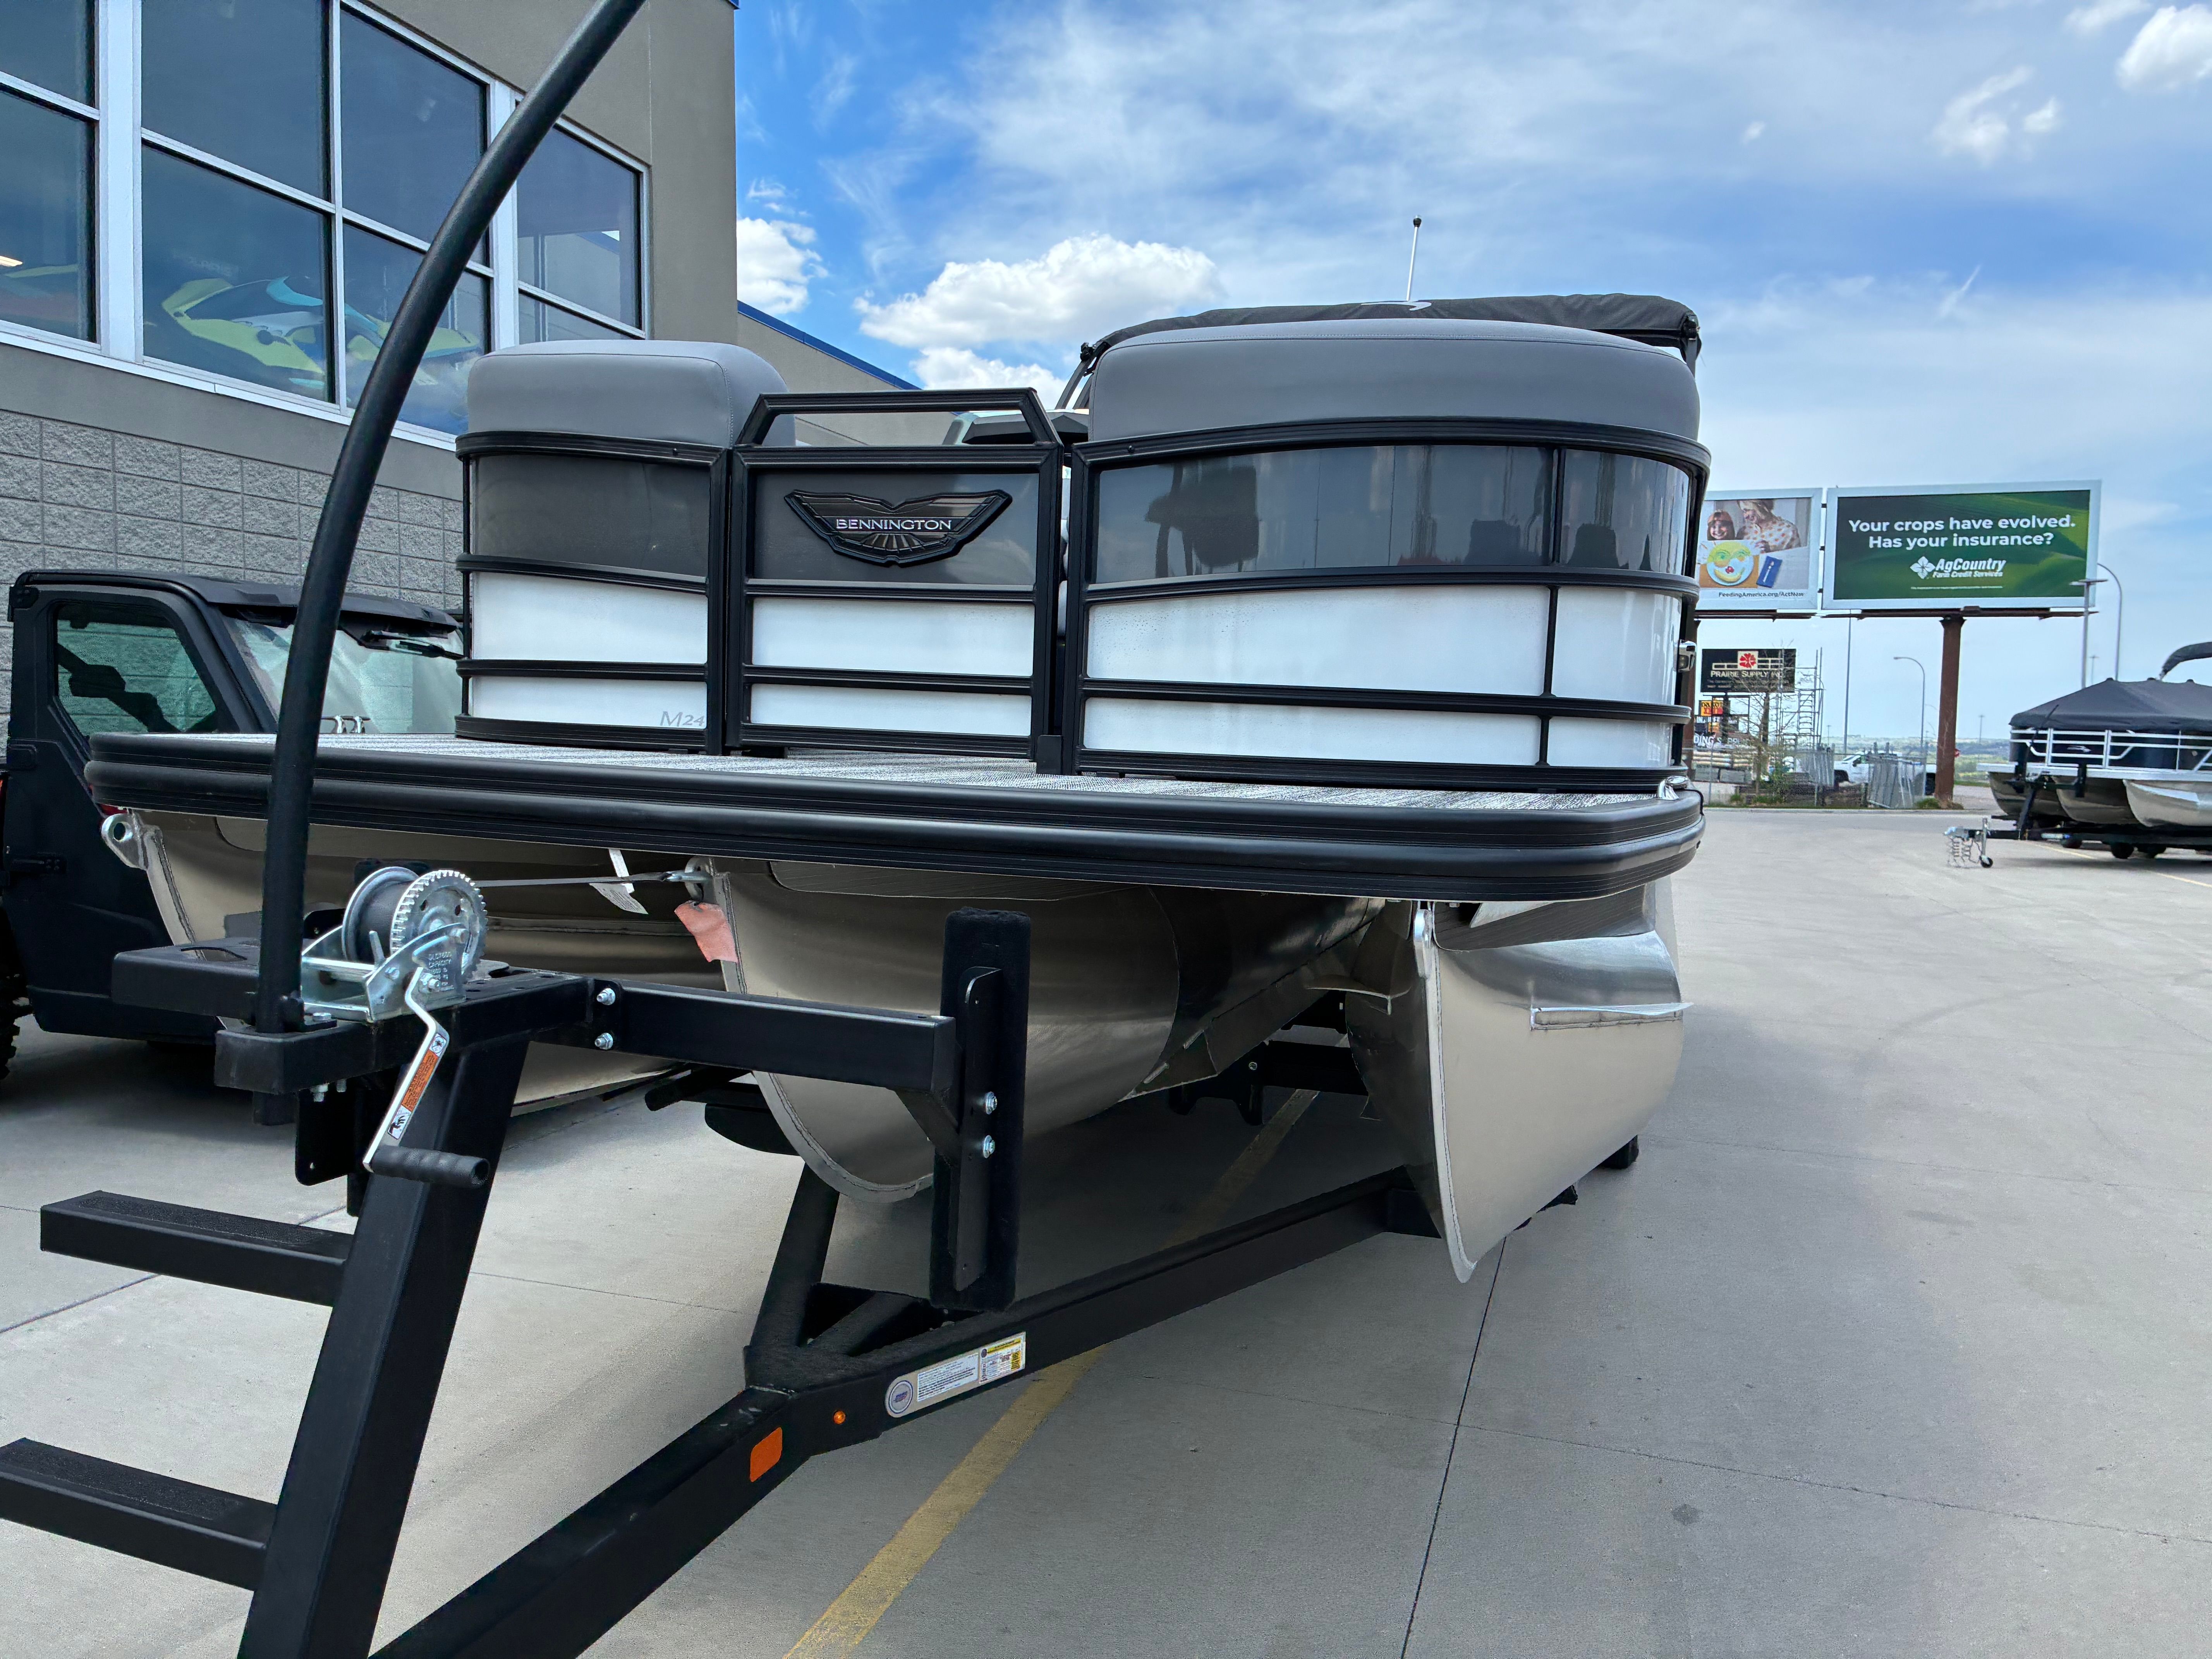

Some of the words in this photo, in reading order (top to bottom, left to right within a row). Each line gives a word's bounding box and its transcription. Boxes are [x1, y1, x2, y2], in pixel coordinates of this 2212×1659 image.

[836, 519, 951, 531] BENNINGTON
[1848, 519, 1890, 532] Your
[1894, 520, 1944, 533] crops
[1949, 517, 1993, 530] have
[1998, 514, 2076, 529] evolved.
[1869, 536, 1902, 548] Has
[1906, 537, 1948, 550] your
[1953, 532, 2054, 546] insurance?
[1936, 558, 2006, 573] AgCountry
[660, 711, 705, 727] M24
